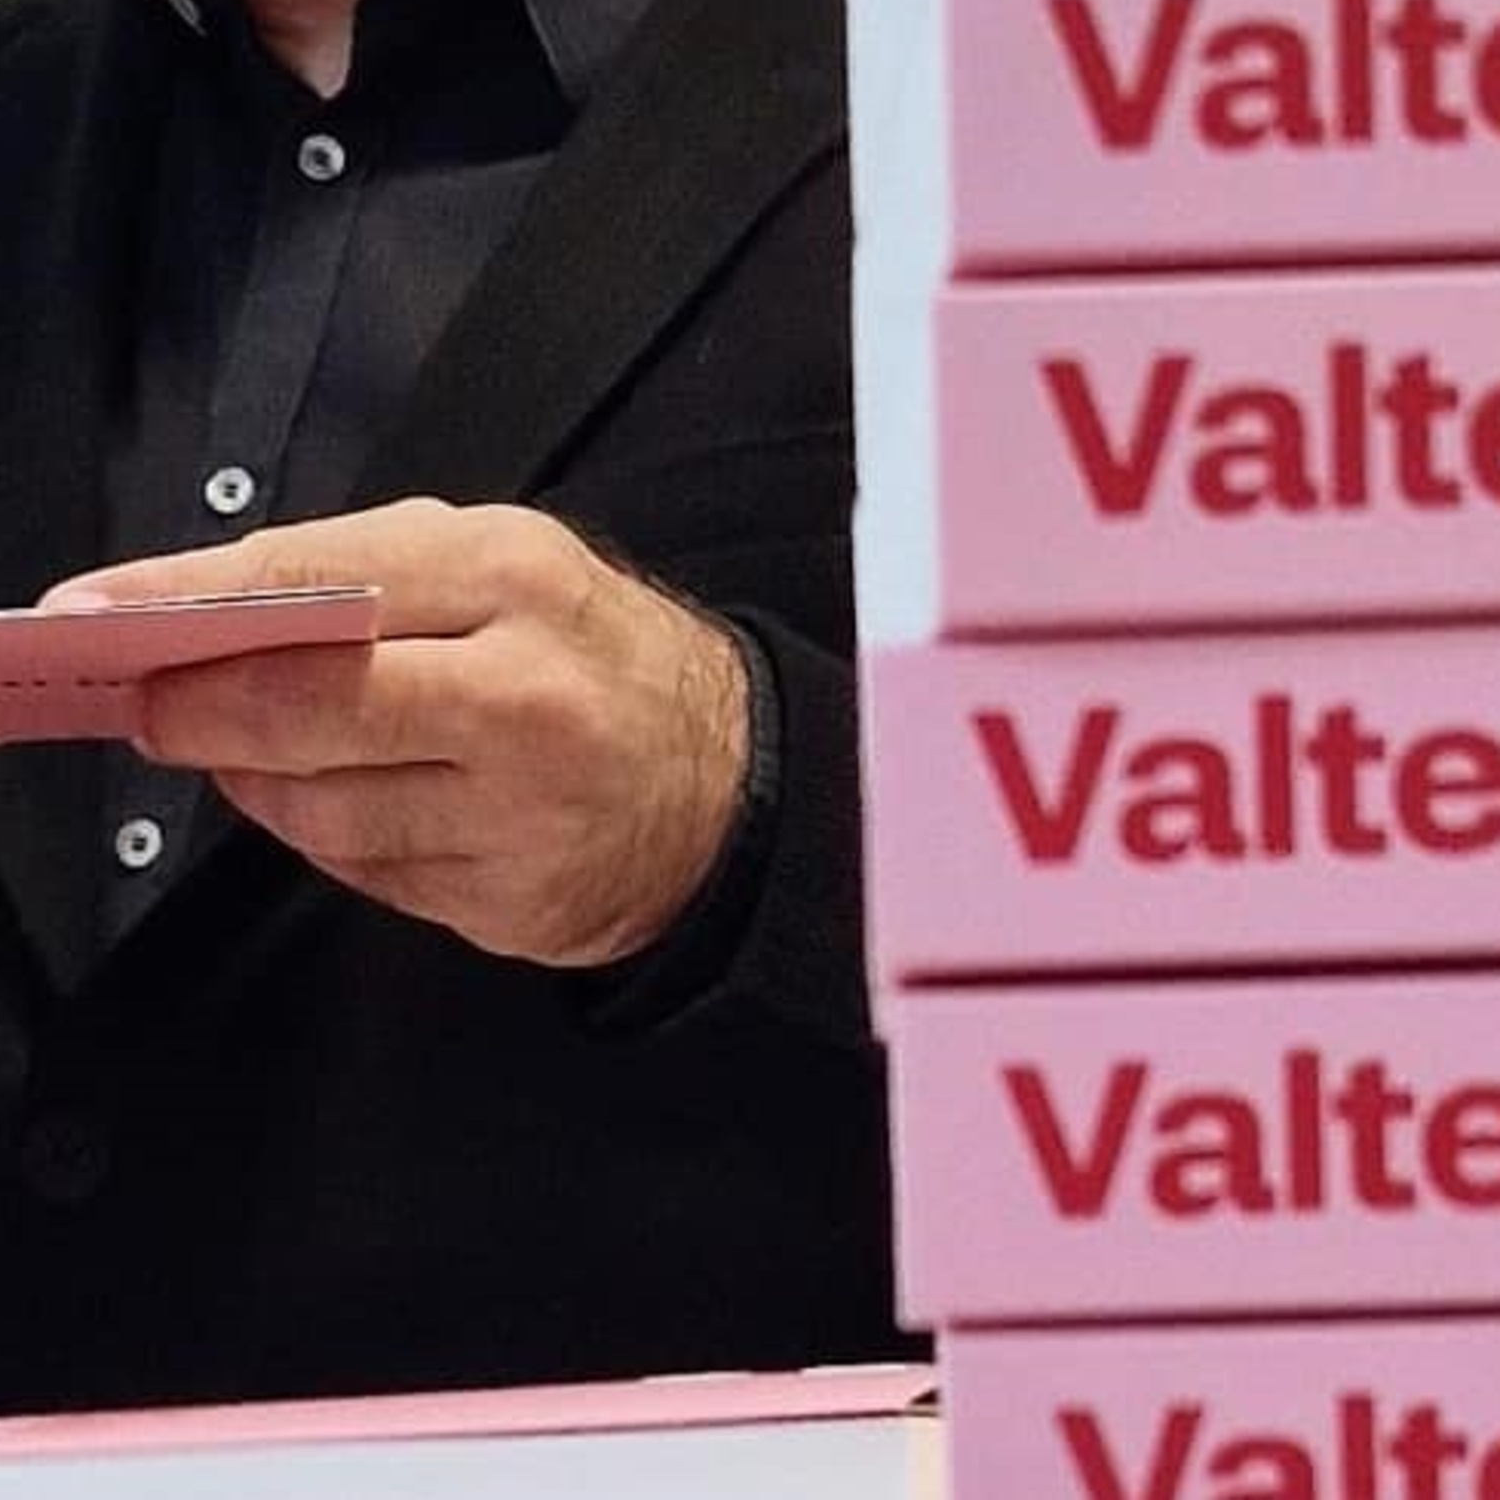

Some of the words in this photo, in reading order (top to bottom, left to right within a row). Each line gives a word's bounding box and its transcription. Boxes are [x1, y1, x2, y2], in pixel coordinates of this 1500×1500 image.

[1039, 341, 1500, 518] Valt
[972, 692, 1500, 867] Valte
[1055, 1392, 1500, 1500] Valt
